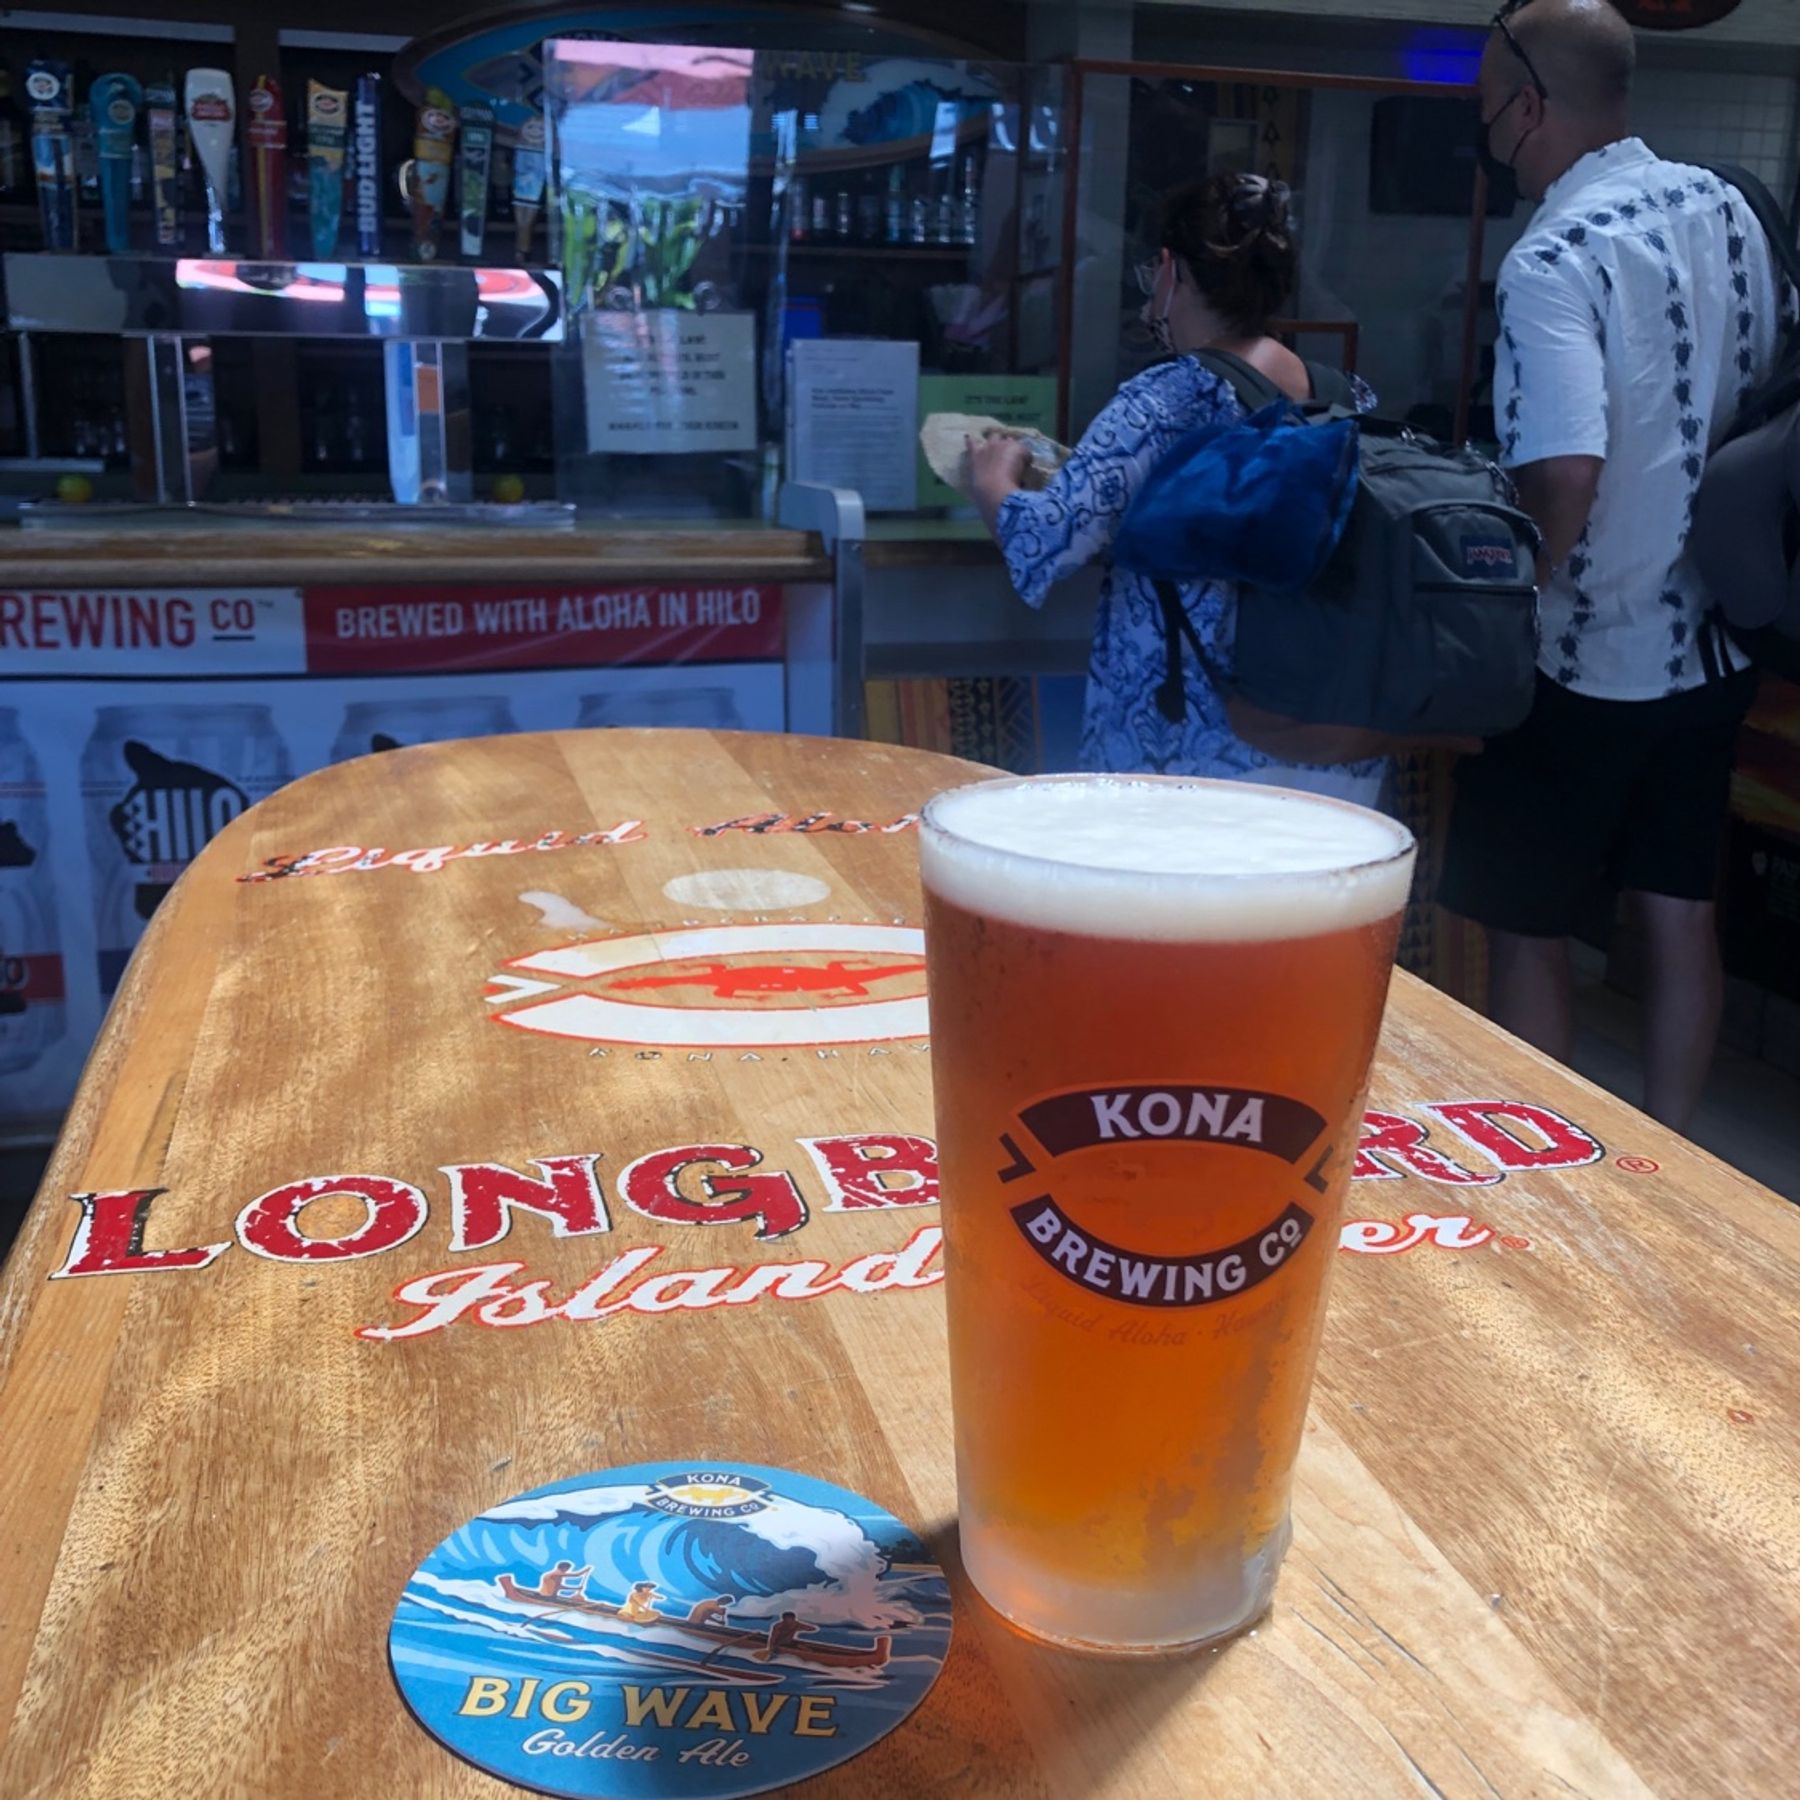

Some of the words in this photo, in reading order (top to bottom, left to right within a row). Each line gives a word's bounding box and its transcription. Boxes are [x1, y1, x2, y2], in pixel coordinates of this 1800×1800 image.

[355, 100, 377, 177] LIGHT
[355, 177, 377, 233] BUD
[0, 594, 197, 649] REWING
[335, 601, 464, 639] BREWED
[473, 597, 548, 635] WITH
[555, 593, 653, 632] ALOHA
[658, 592, 689, 627] IN
[695, 588, 761, 626] HILO
[1090, 1092, 1267, 1143] KONA
[47, 1099, 1606, 1281] LONGBRD
[1025, 1206, 1248, 1302] BREWING
[354, 1224, 945, 1342] Island
[1108, 1319, 1187, 1347] Aloha
[655, 1497, 736, 1517] BREWING
[686, 1473, 741, 1486] KONA
[453, 1674, 594, 1724] BIG
[618, 1682, 842, 1740] WAVE
[521, 1727, 661, 1764] Golden
[677, 1736, 753, 1769] Ale
